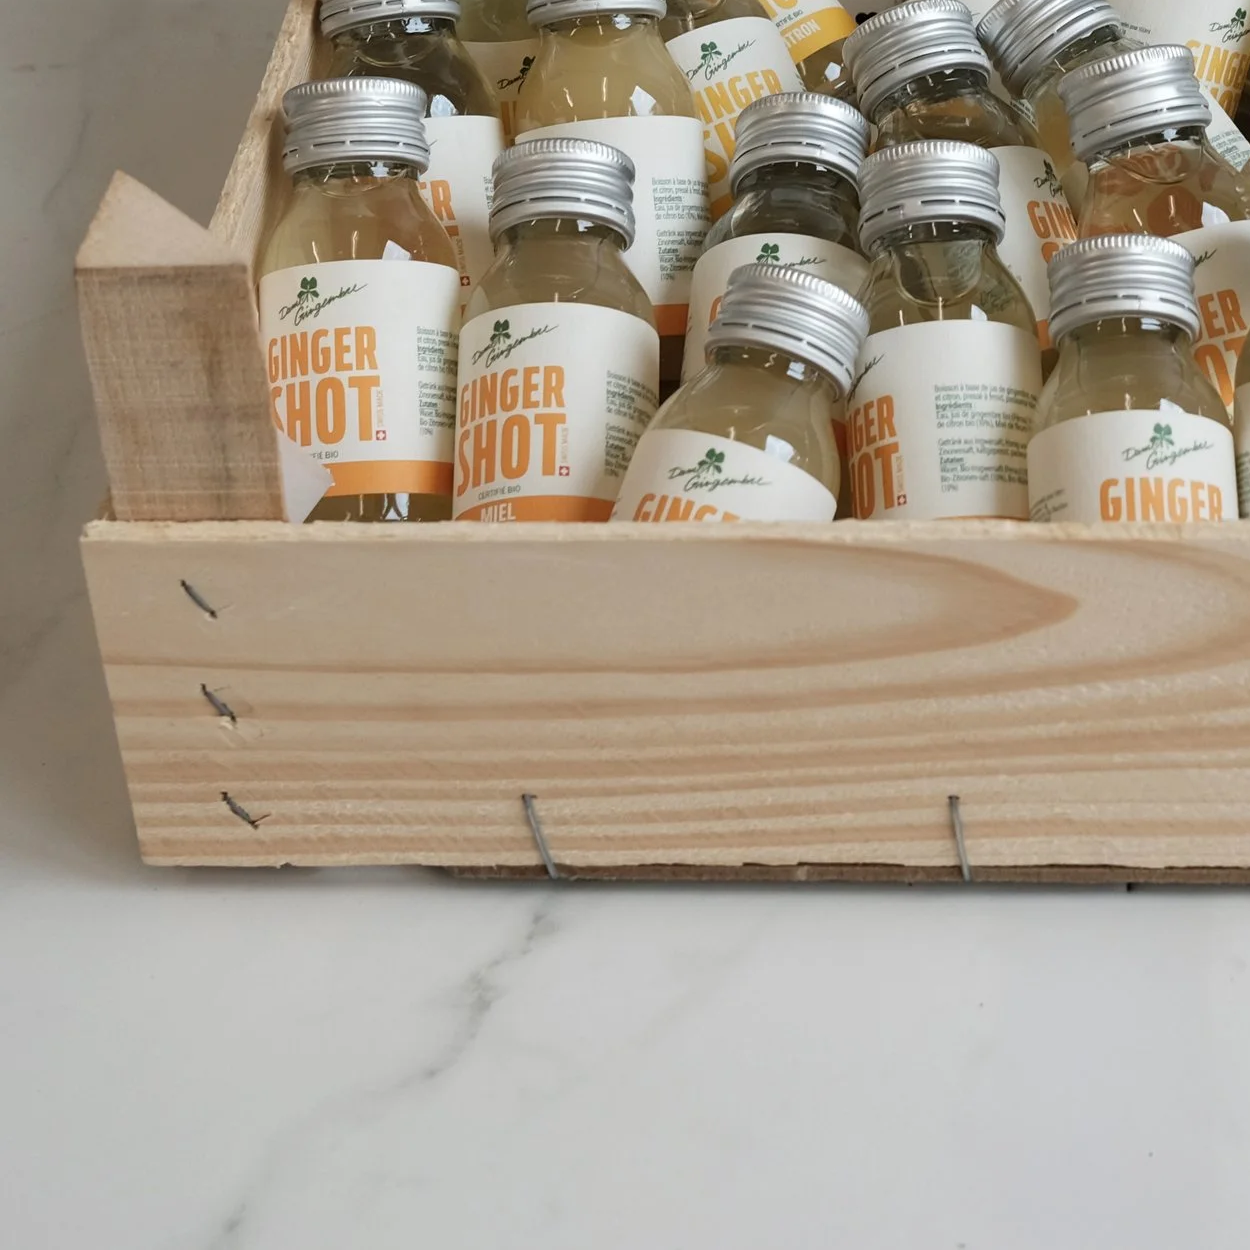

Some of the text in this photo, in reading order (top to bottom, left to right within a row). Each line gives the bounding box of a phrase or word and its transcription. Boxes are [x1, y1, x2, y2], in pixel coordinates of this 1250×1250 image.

[694, 68, 783, 125] INGER
[1027, 200, 1078, 241] GIN
[268, 326, 379, 383] GINGER
[459, 365, 565, 429] GINGER
[849, 394, 898, 454] GER
[457, 413, 567, 498] SHOT
[480, 502, 517, 522] MIEL
[1100, 477, 1223, 523] GINGER
